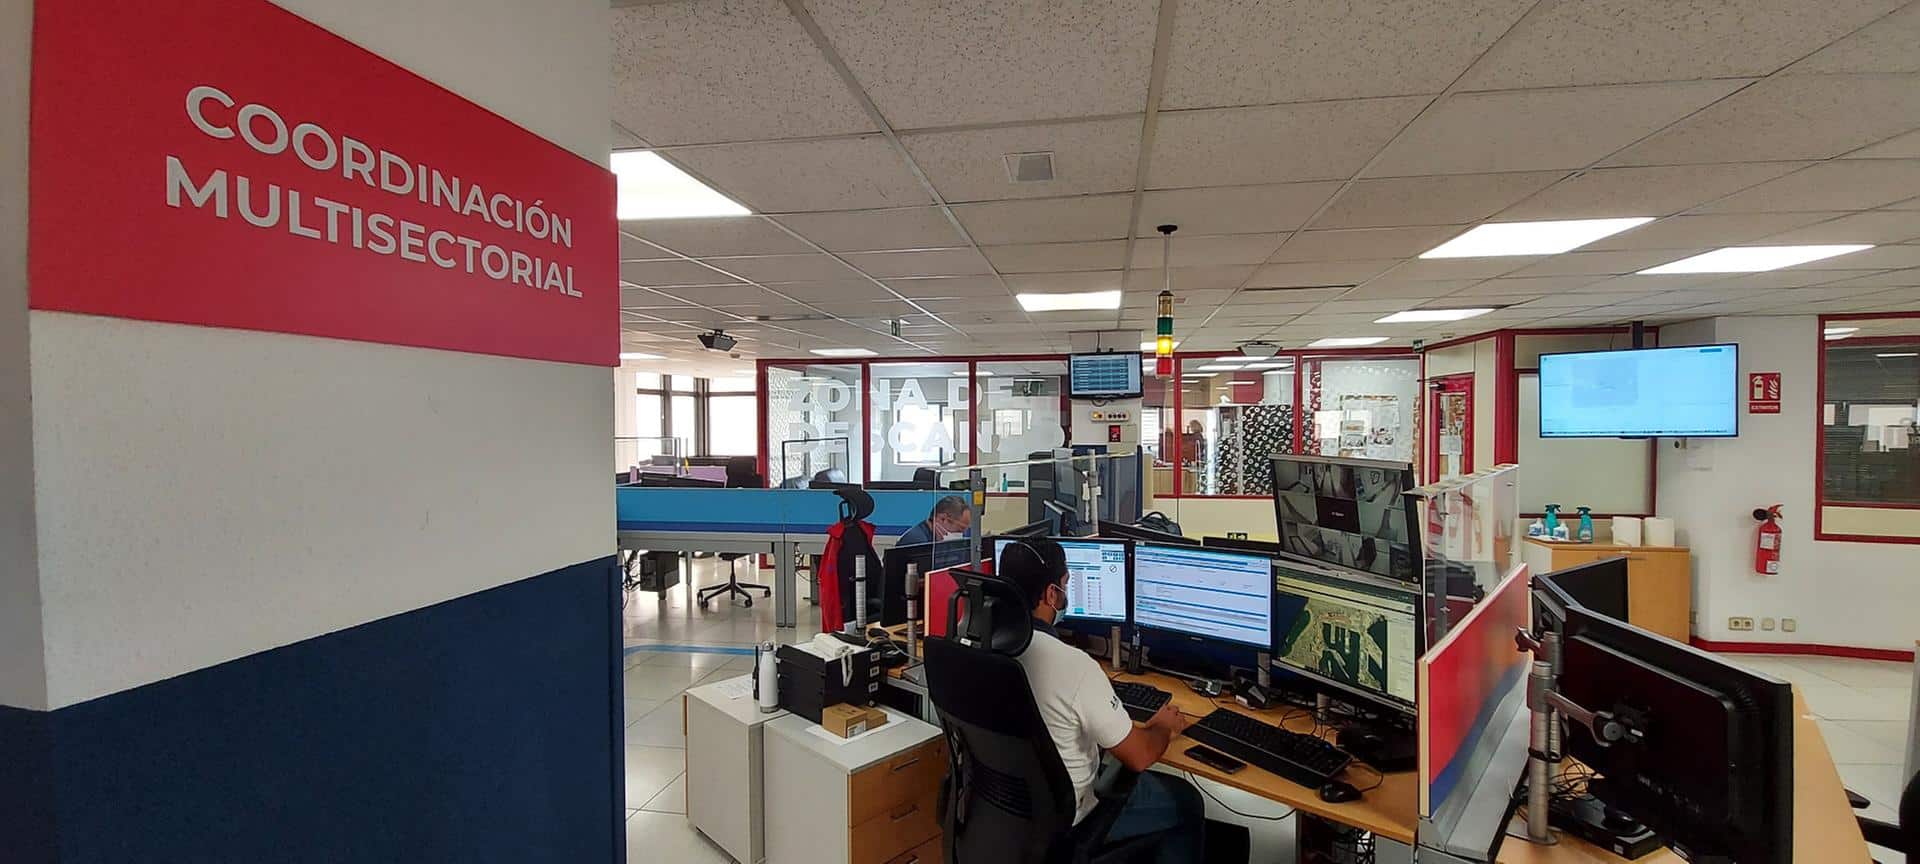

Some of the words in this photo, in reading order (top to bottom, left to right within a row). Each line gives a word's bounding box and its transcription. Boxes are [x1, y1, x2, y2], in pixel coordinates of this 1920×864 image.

[186, 86, 571, 248] COORDINACIÓN
[166, 155, 583, 298] MULTISECTORIAL
[789, 421, 1065, 454] DESCAN
[790, 379, 928, 411] ZONA
[947, 378, 1014, 410] DE
